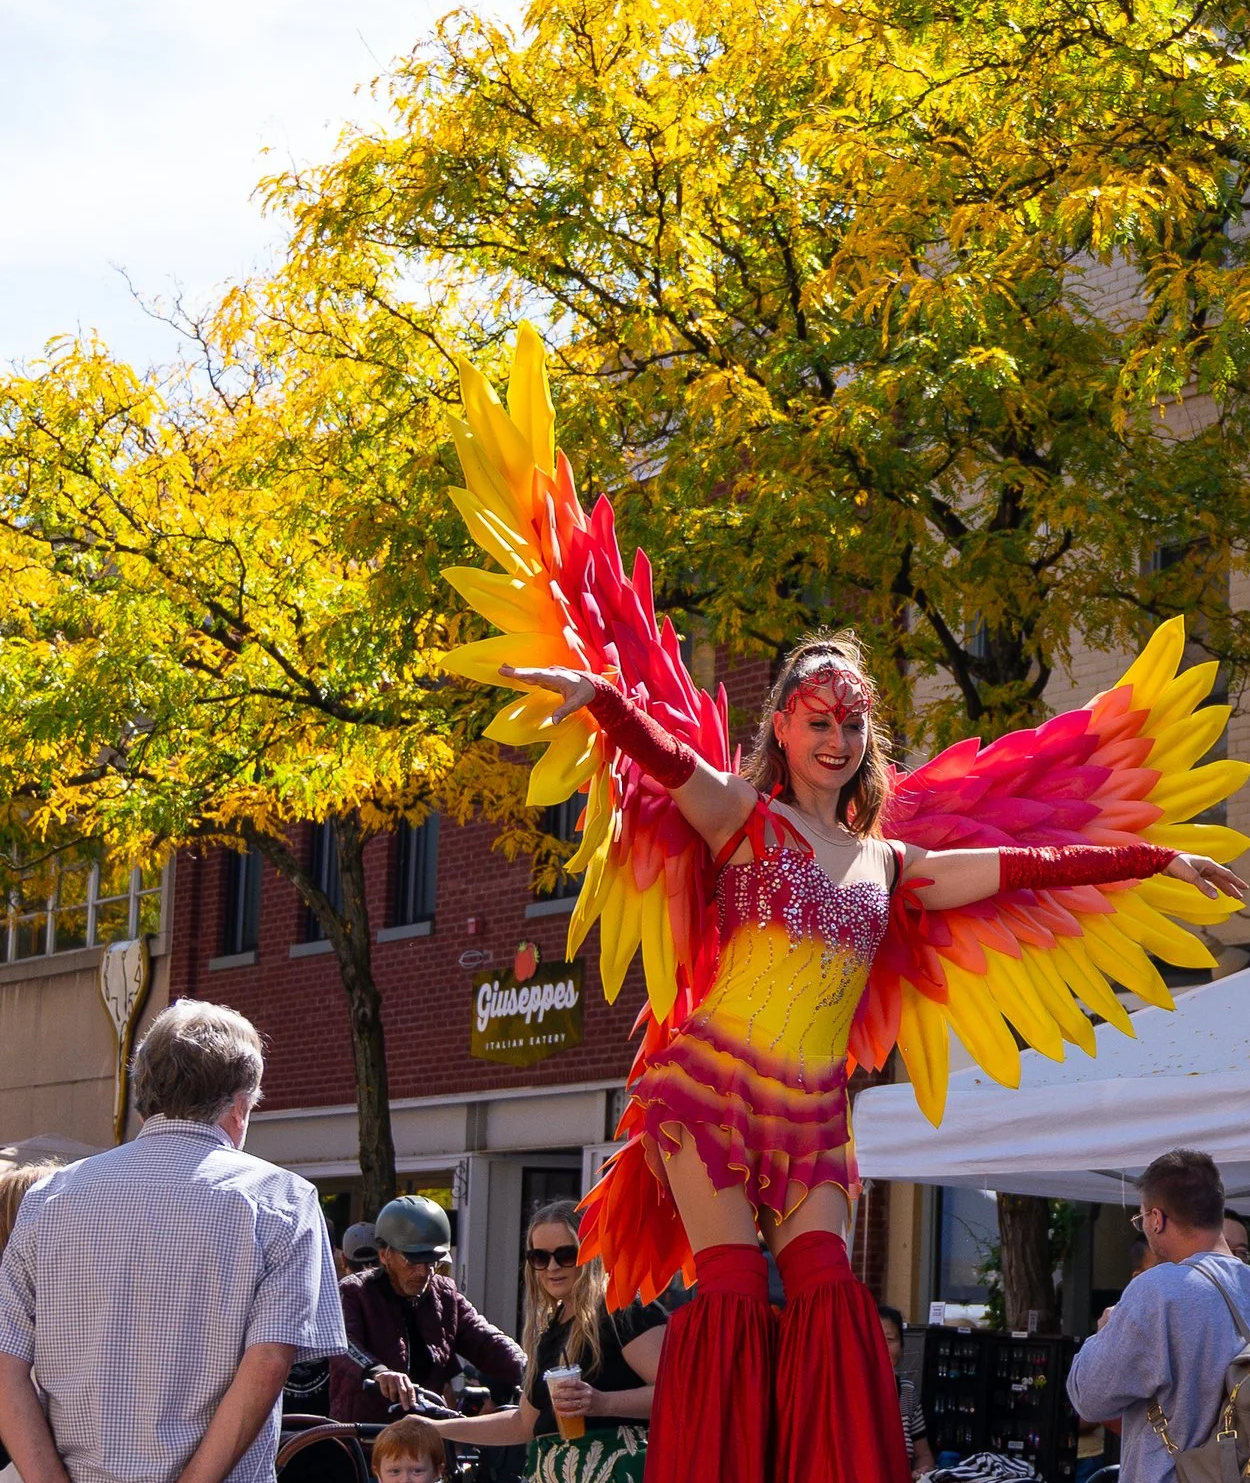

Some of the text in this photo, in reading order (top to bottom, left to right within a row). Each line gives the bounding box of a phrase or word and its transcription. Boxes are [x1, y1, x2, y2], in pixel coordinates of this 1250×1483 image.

[476, 979, 579, 1032] Giuseppes
[485, 1033, 566, 1050] ITALIAN EATERY
